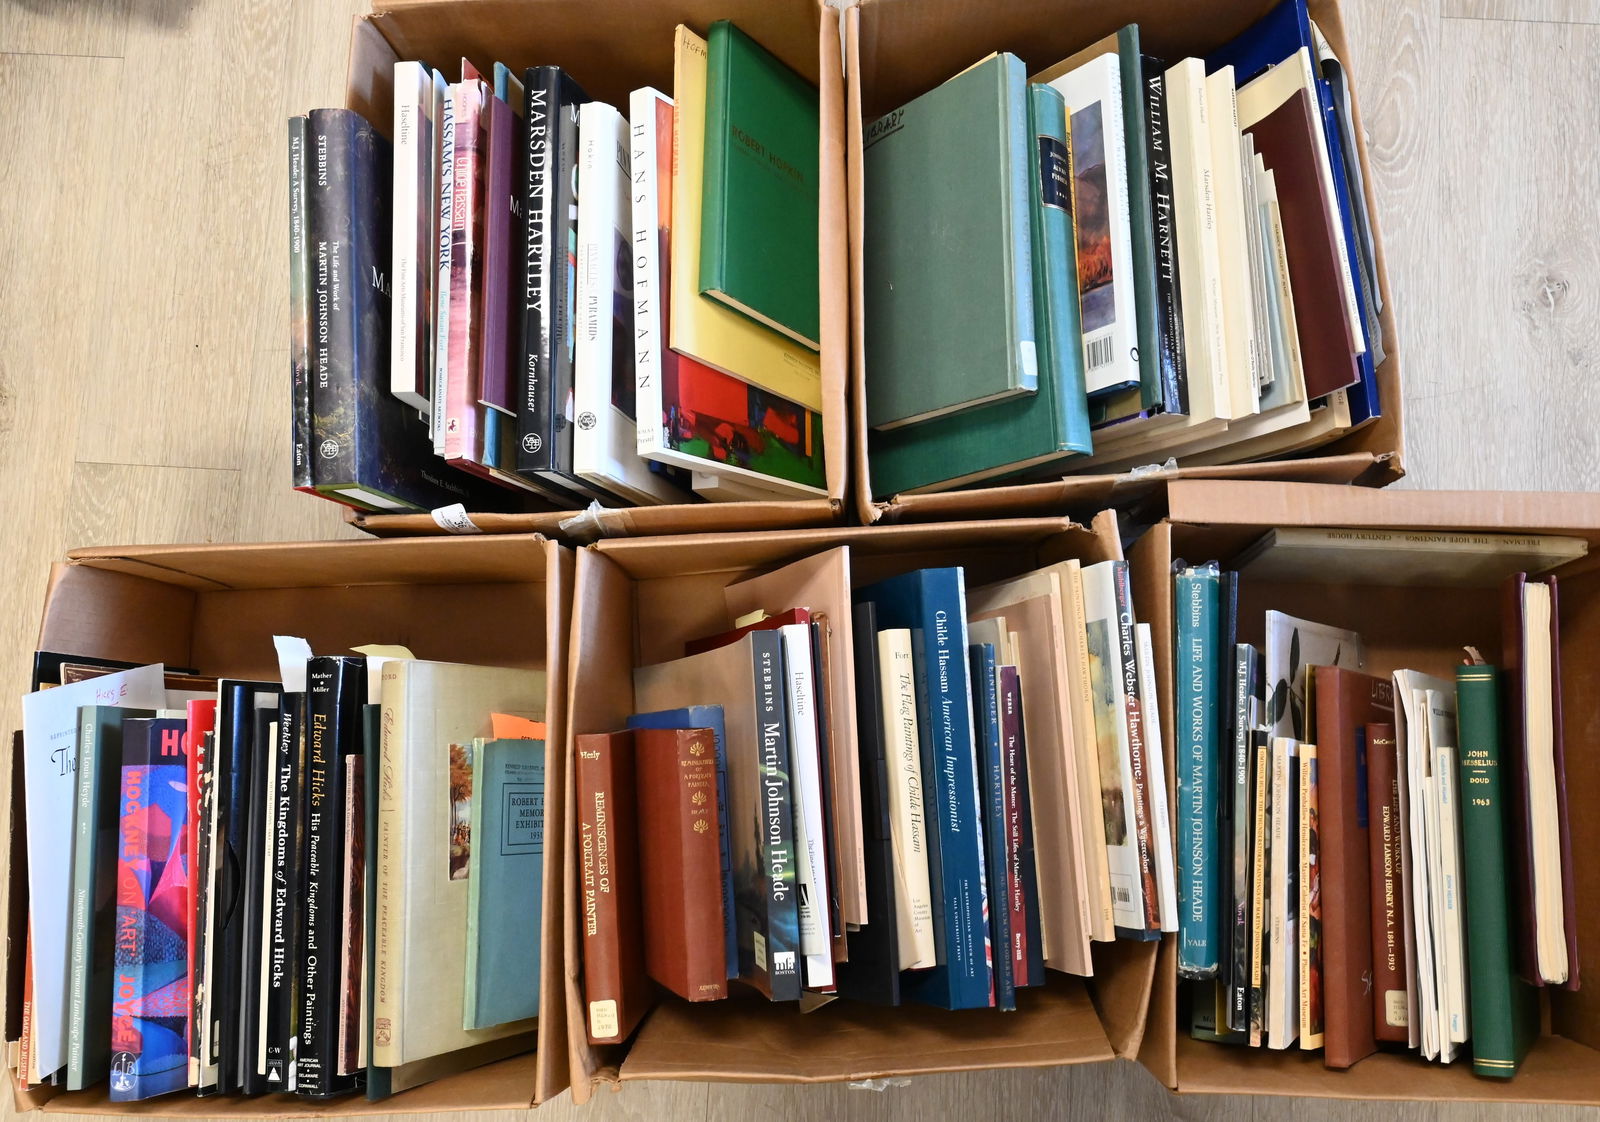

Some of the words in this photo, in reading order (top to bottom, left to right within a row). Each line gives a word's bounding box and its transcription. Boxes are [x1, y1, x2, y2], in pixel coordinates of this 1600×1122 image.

[400, 104, 410, 145] Haseltine
[1149, 75, 1163, 151] WILLIAM
[442, 98, 453, 177] HASSAM'S
[529, 89, 546, 197] MARSDEN
[318, 135, 328, 187] STEBBINS
[633, 124, 646, 203] HANS
[1154, 160, 1168, 183] M.
[440, 182, 452, 220] NEW
[332, 241, 340, 254] The
[439, 225, 450, 272] YORK
[1157, 192, 1172, 283] HARNETT
[318, 242, 328, 286] MARTIN
[332, 256, 340, 268] Life
[332, 270, 340, 282] and
[526, 208, 544, 312] HARTLEY
[332, 284, 340, 302] Work
[636, 229, 650, 389] HOFMANN
[318, 289, 328, 342] JOHNSON
[320, 348, 328, 388] HEADE
[528, 354, 538, 412] Kornhauser
[1191, 583, 1202, 627] Stebbins
[935, 610, 947, 646] Childe
[1120, 612, 1131, 656] Charles
[938, 649, 950, 693] Hassam
[1192, 638, 1203, 662] LIFE
[1238, 660, 1246, 676] M.J.
[763, 652, 774, 712] STEBBINS
[795, 672, 806, 716] Haseltine
[899, 673, 910, 690] The
[1125, 659, 1136, 707] Webster
[1192, 665, 1203, 692] AND
[1237, 679, 1246, 705] Heade:
[900, 693, 912, 715] Flag
[942, 695, 954, 751] American
[1192, 695, 1203, 742] WORKS
[84, 723, 94, 754] Charles
[281, 713, 292, 754] Weekley
[312, 713, 327, 763] Edward
[383, 708, 394, 762] Edward
[764, 722, 781, 776] Martin
[903, 718, 915, 761] Paintings
[988, 659, 997, 724] FEININGER
[993, 765, 1001, 819] HARTLEY
[1130, 711, 1142, 780] Hawthorne:
[1237, 715, 1246, 742] Survey,
[83, 756, 92, 778] Louis
[580, 751, 600, 760] Healy
[904, 764, 917, 774] of
[1192, 745, 1203, 761] OF
[1237, 744, 1246, 784] 1840-1900
[81, 781, 90, 808] Heyde
[281, 764, 291, 792] The
[312, 769, 325, 806] Hicks
[382, 765, 394, 801] Hicks
[907, 776, 920, 810] Childe
[944, 755, 960, 833] Impressionist
[1192, 765, 1203, 814] MARTIN
[124, 770, 141, 870] HOCKNEY
[311, 813, 320, 831] His
[512, 798, 538, 806] ROBERT
[765, 780, 783, 845] Johnson
[1135, 783, 1146, 819] Paintings
[277, 796, 290, 866] Kingdoms
[582, 823, 591, 831] A
[594, 792, 609, 875] REMINISCENCES
[910, 812, 922, 852] Hassam
[1191, 817, 1203, 876] JOHNSON
[310, 834, 320, 876] Peaceable
[382, 865, 388, 876] OF
[583, 834, 594, 886] PORTRAIT
[1140, 827, 1150, 874] Watercolors
[1384, 843, 1392, 877] LAMSON
[123, 876, 136, 904] ON
[275, 870, 287, 884] of
[600, 878, 610, 893] OF
[770, 849, 789, 902] Heade
[1385, 879, 1393, 908] HENRY
[274, 888, 286, 942] Edward
[308, 882, 318, 926] Kingdoms
[586, 890, 597, 937] PAINTER
[1192, 880, 1203, 922] HEADE
[73, 888, 86, 962] Nineteenth-Century
[120, 911, 137, 957] 'ART'
[308, 930, 317, 949] and
[74, 965, 83, 998] Vermont
[273, 947, 284, 987] Hicks
[307, 955, 317, 989] Other
[72, 999, 81, 1041] Landscape
[118, 974, 136, 1042] JOYCE
[304, 993, 315, 1045] Paintings
[22, 1016, 30, 1050] OAKLAND
[71, 1042, 80, 1072] Painter
